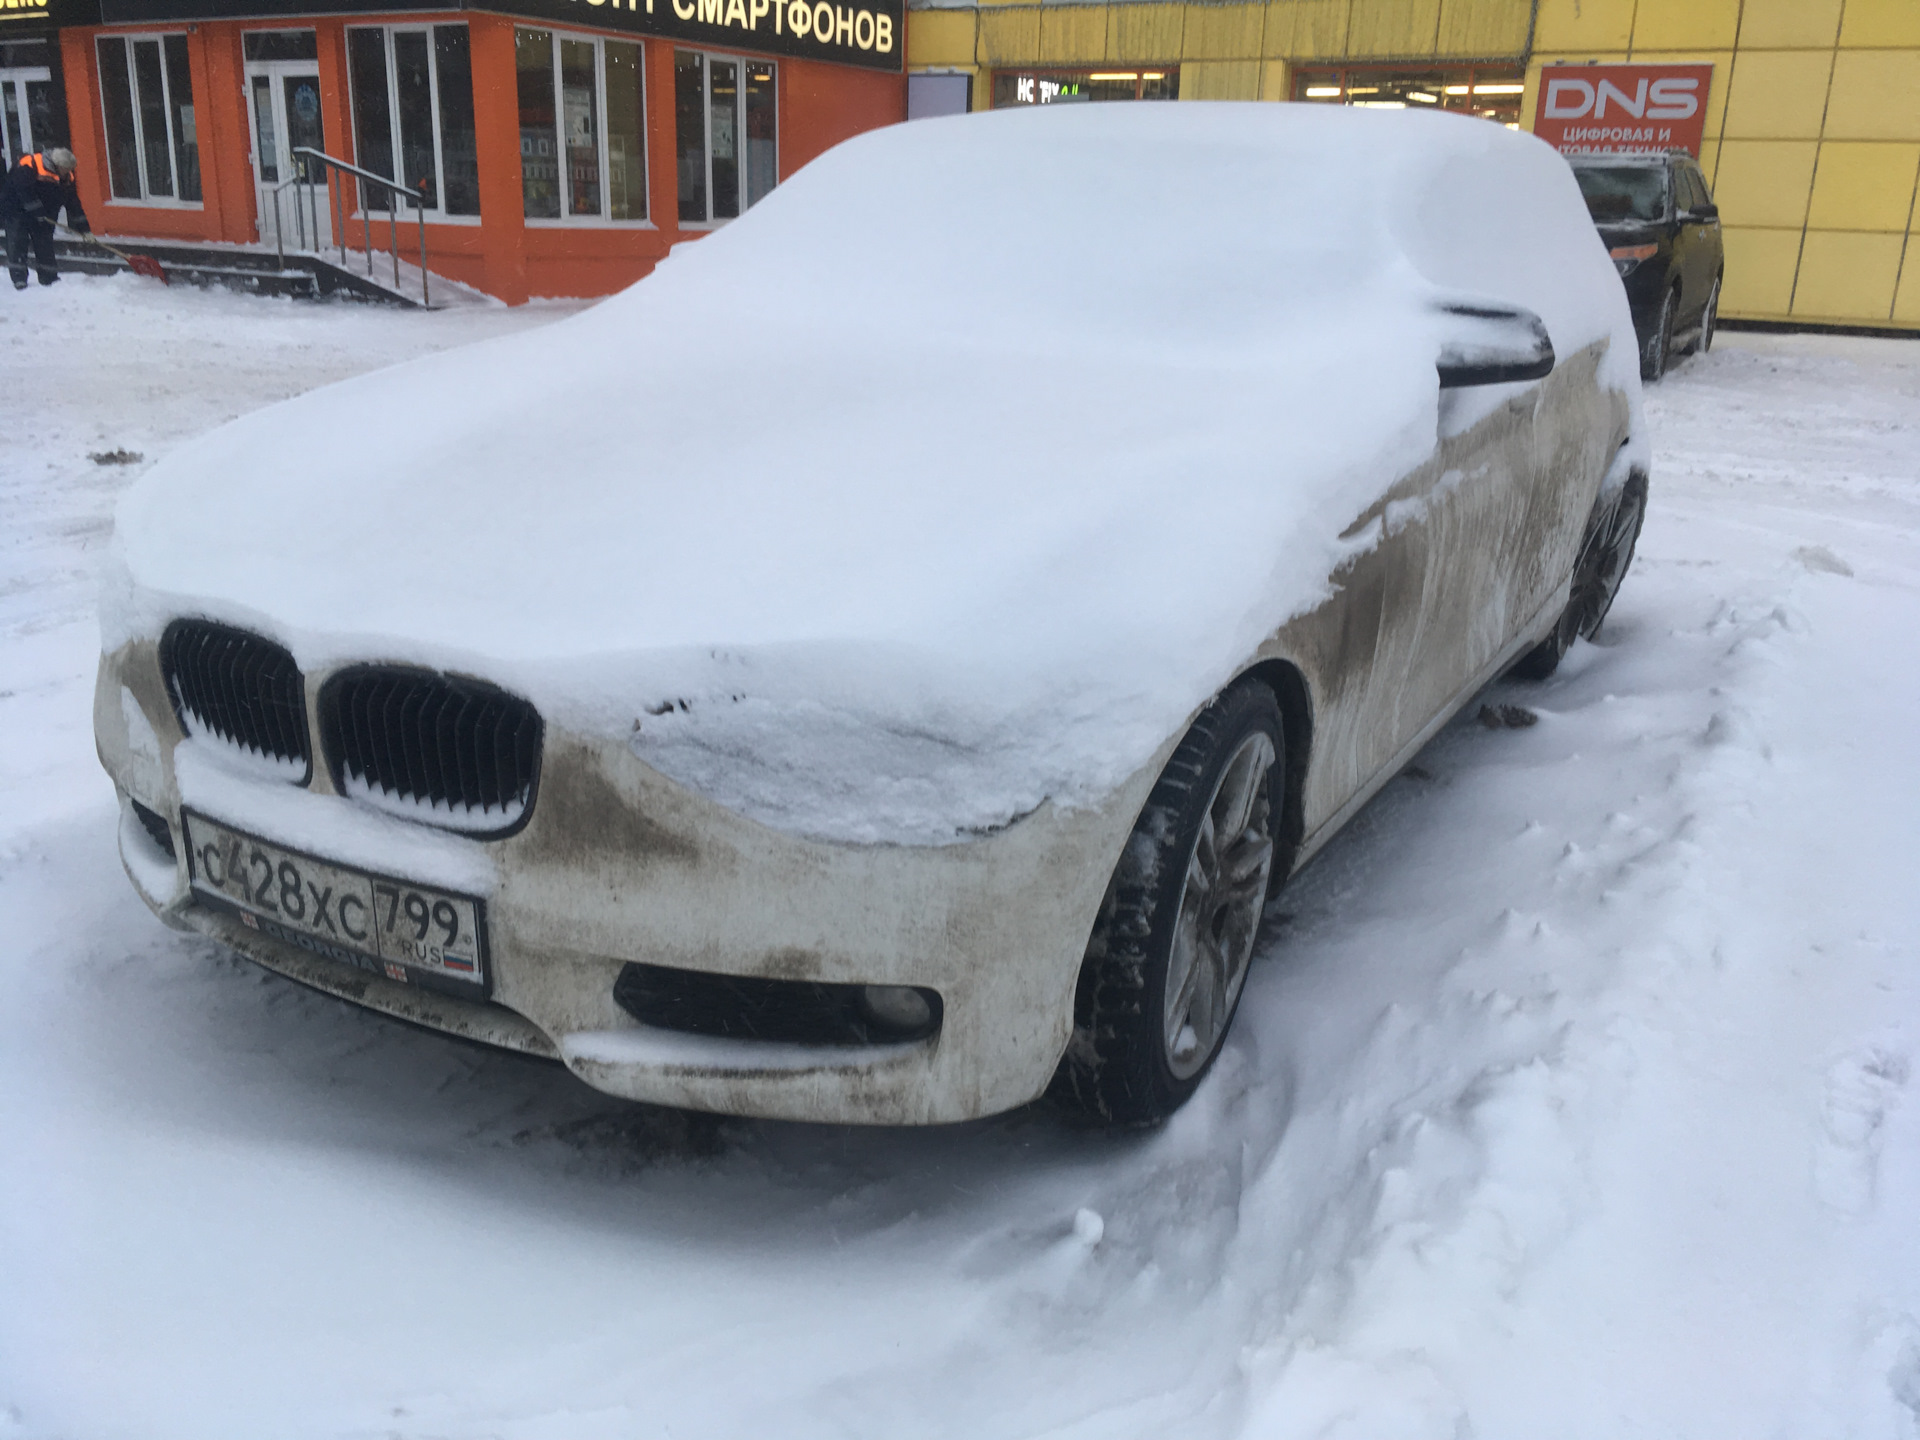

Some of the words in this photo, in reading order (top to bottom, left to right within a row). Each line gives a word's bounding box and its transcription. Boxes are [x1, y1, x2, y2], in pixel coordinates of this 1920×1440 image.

[672, 0, 893, 53] СМАРТФОНОВ
[1544, 78, 1699, 119] DNS
[1563, 127, 1654, 143] ЦИФРОВАЯ
[1658, 127, 1672, 142] И
[375, 884, 459, 947] 799
[402, 940, 441, 963] RUS
